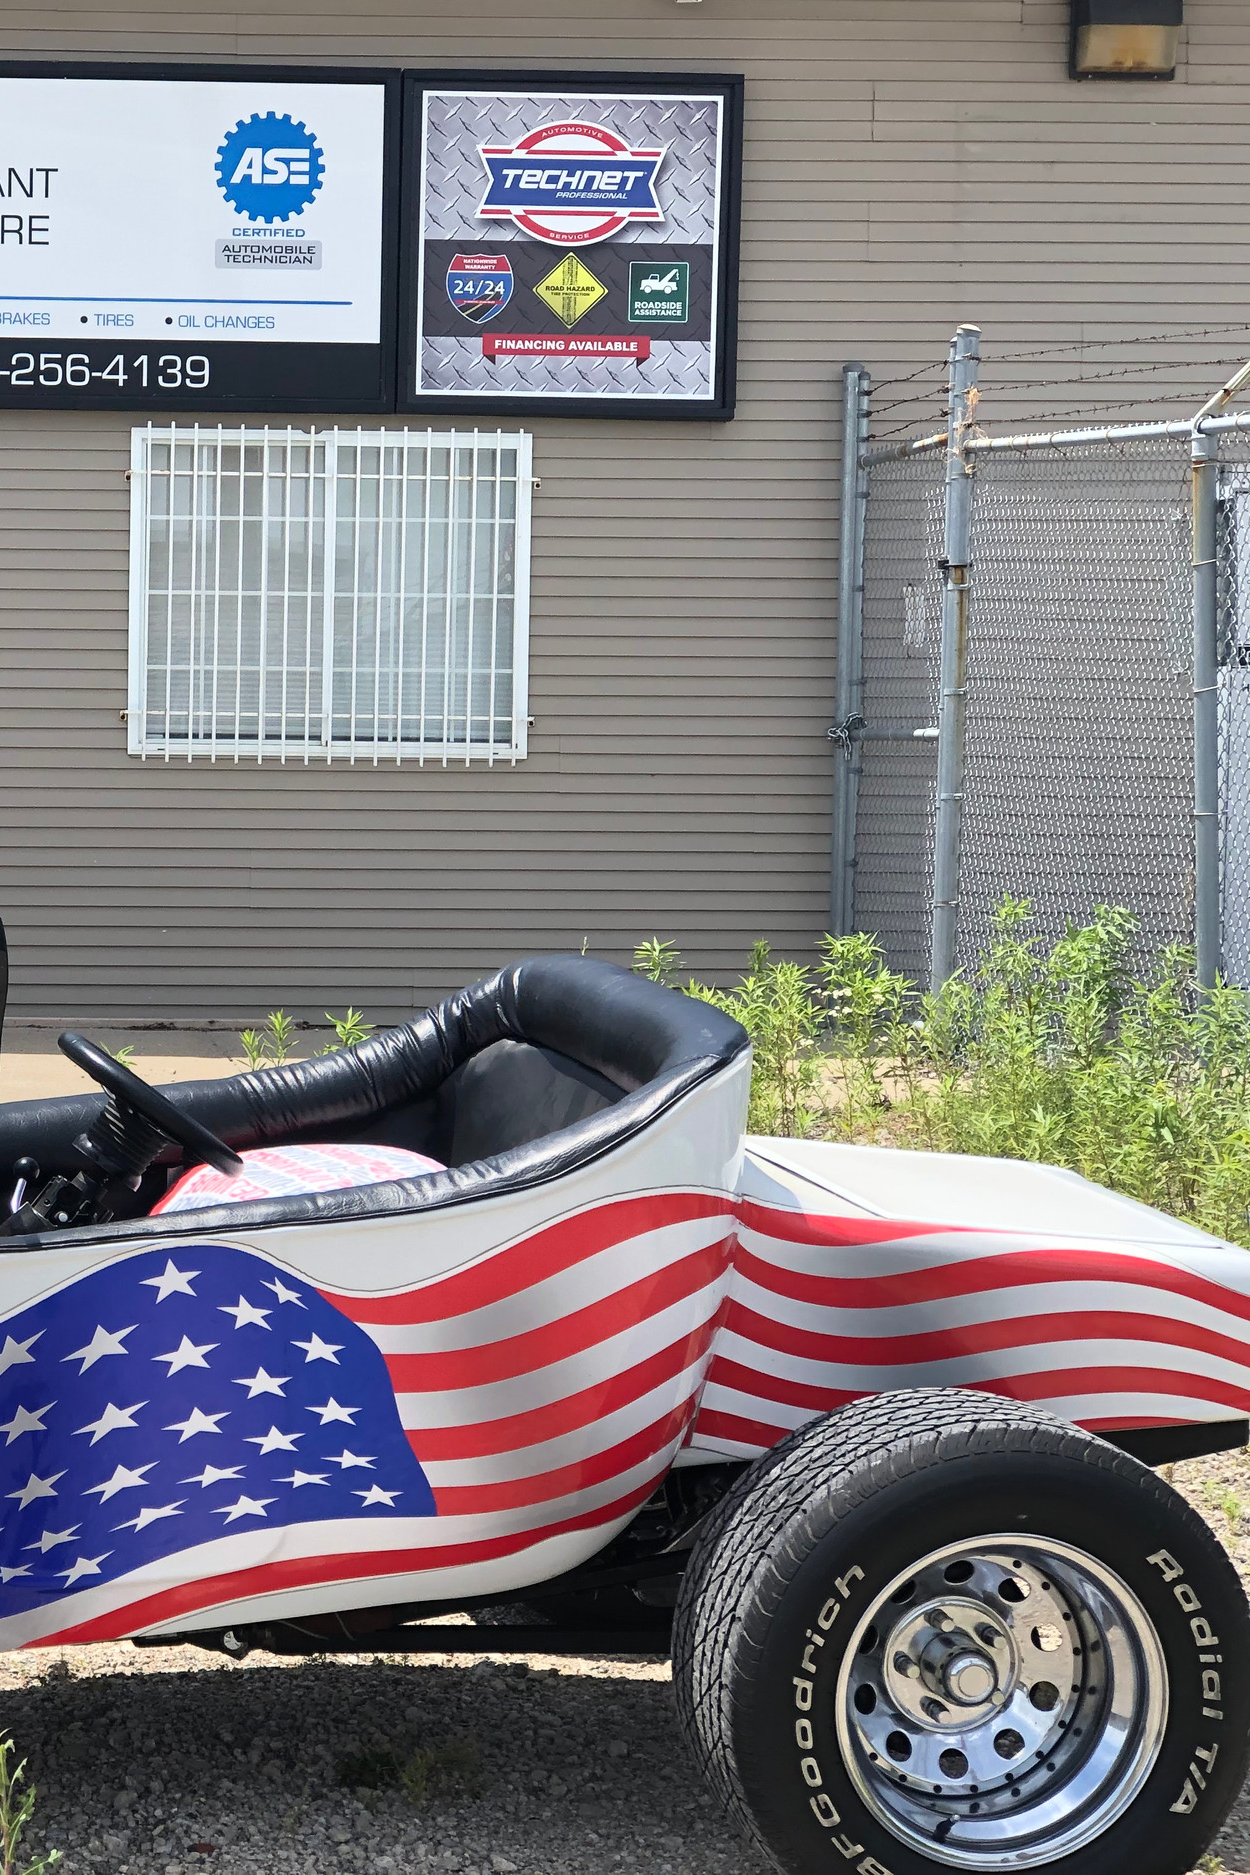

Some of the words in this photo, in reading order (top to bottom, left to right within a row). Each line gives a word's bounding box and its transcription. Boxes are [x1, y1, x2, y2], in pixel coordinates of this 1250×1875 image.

[541, 127, 604, 139] AUTOMOTIVE
[229, 147, 311, 185] ASE
[501, 168, 645, 191] TECHNET
[555, 191, 628, 200] PROFESSIONAL
[232, 227, 306, 238] CERTIFIED
[549, 232, 590, 240] SERVICE
[221, 244, 317, 255] AUTOMOBILE
[224, 254, 314, 265] TECHNICIAN
[453, 280, 506, 296] 24/24
[634, 301, 683, 310] ROADSIDE
[634, 308, 682, 317] ASSISTANCE
[93, 313, 135, 327] TIRES
[177, 314, 202, 329] OIL
[204, 315, 275, 330] CHANGES
[494, 339, 565, 351] FINANCING
[568, 341, 638, 352] AVAILABLE
[1146, 1549, 1224, 1720] Radial
[793, 1564, 894, 1875] BFGoodrich
[1169, 1743, 1219, 1814] T/A
